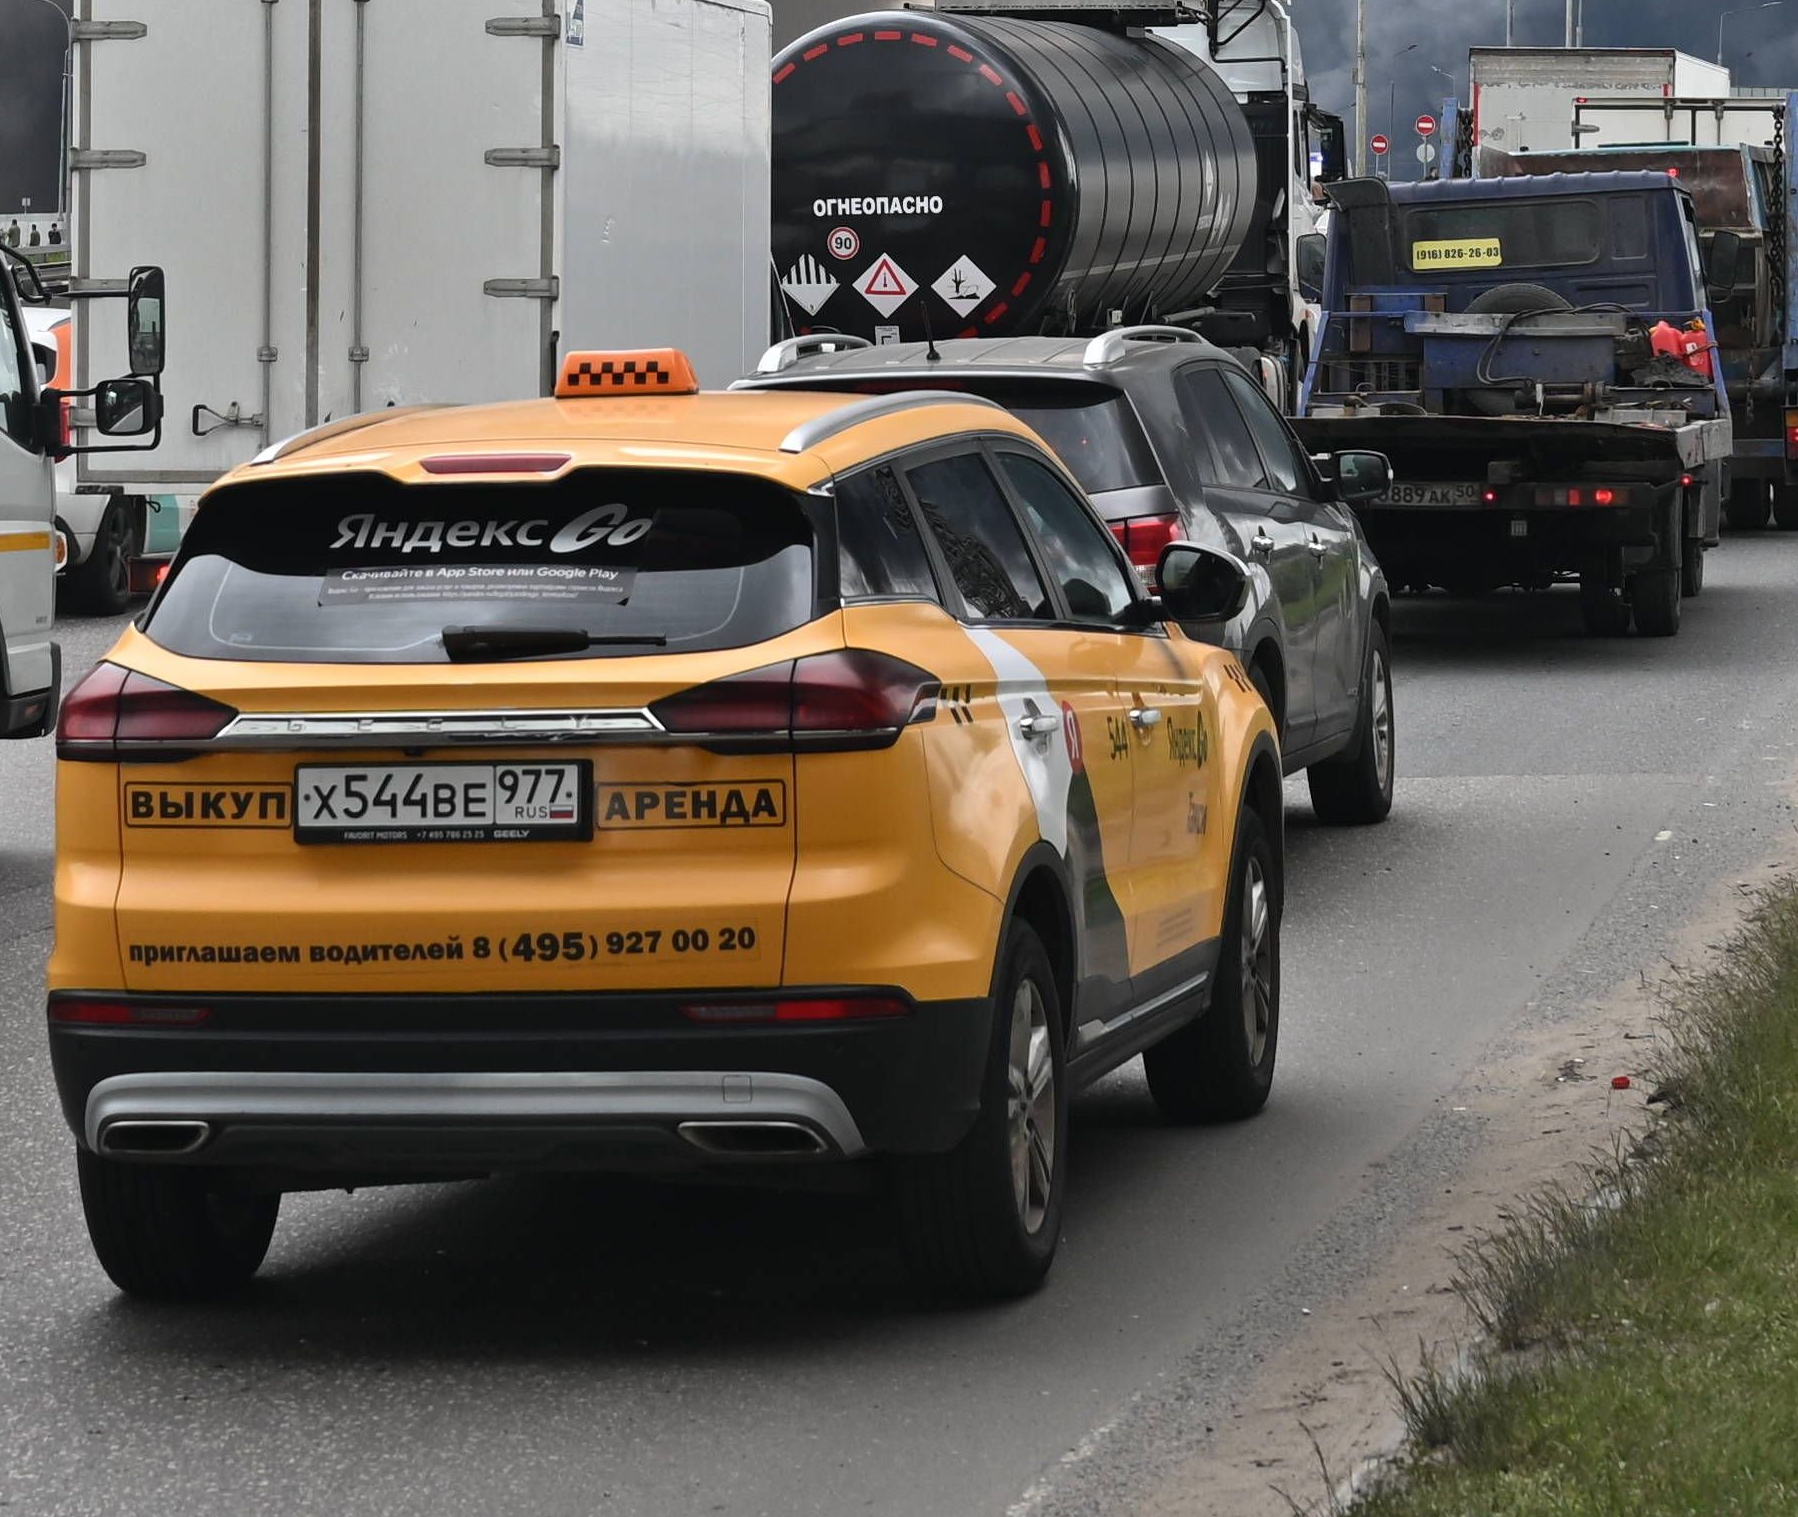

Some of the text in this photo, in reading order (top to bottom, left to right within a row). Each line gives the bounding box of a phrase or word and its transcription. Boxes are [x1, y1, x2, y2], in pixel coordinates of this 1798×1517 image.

[813, 195, 944, 217] ОГНЕОПАСНО
[834, 236, 853, 250] 90
[329, 503, 654, 554] Яндекс Go
[341, 568, 422, 581] Скачивайте
[436, 567, 465, 578] App
[467, 566, 505, 577] Store
[507, 568, 533, 577] или
[536, 566, 587, 580] Google
[589, 567, 619, 581] Play
[287, 715, 588, 732] GEELY
[1065, 710, 1080, 759] Я
[1106, 716, 1129, 761] 544
[497, 769, 566, 805] 977
[131, 791, 286, 820] ВЫКУП
[514, 806, 548, 819] RUS
[604, 788, 777, 825] АРЕНДА
[493, 829, 531, 839] GEELY
[129, 925, 756, 968] приглашаем водителей 8 (495) 927 00 20
